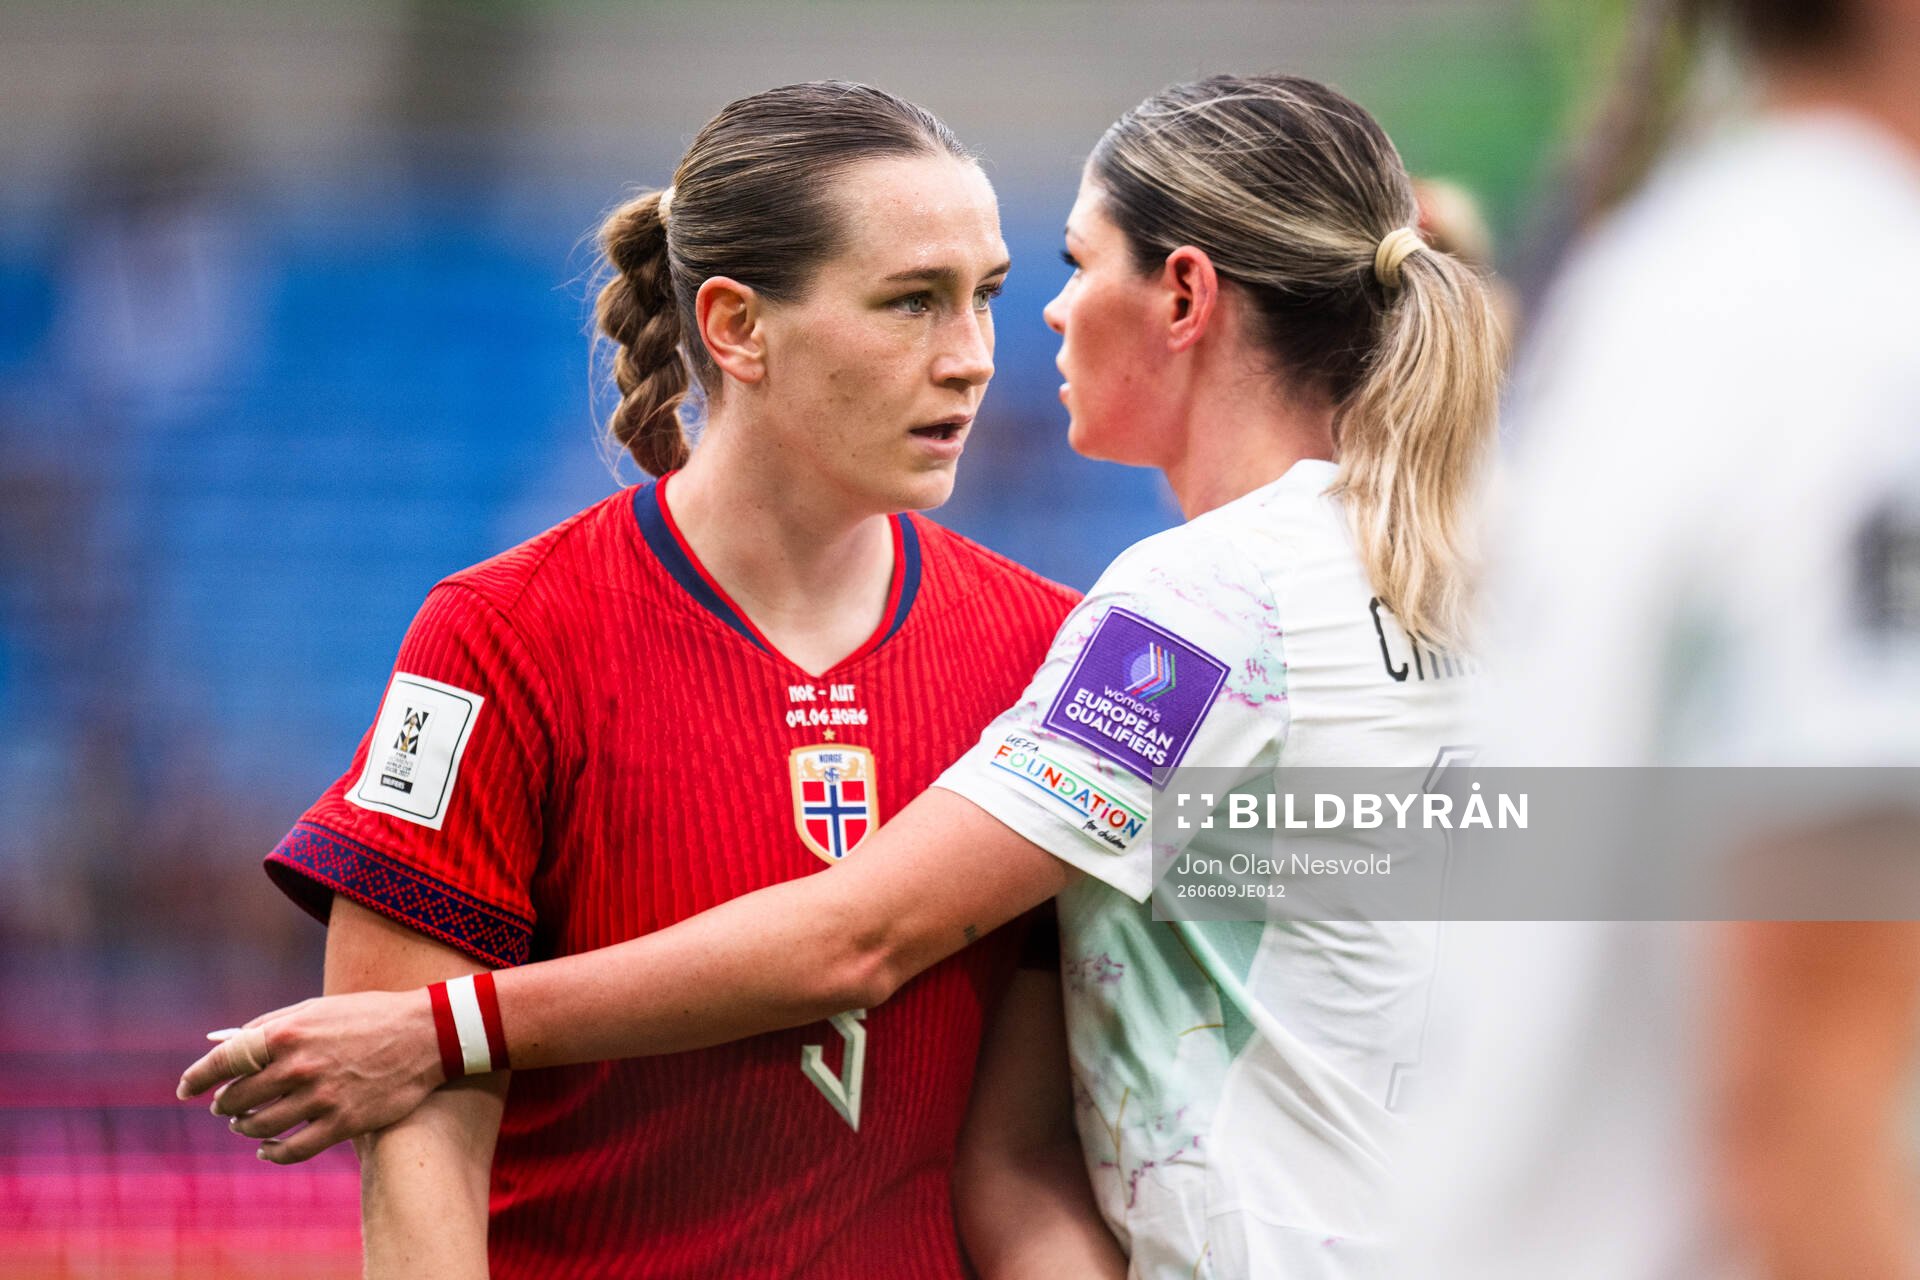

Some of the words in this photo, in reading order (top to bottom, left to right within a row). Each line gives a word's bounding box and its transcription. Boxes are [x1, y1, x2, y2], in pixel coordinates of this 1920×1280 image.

[829, 684, 856, 702] AUT
[1073, 687, 1174, 750] EUROPEAN
[1005, 734, 1039, 753] UEFA
[1065, 703, 1167, 766] QUALIFIERS
[994, 744, 1143, 838] FOUNDATION
